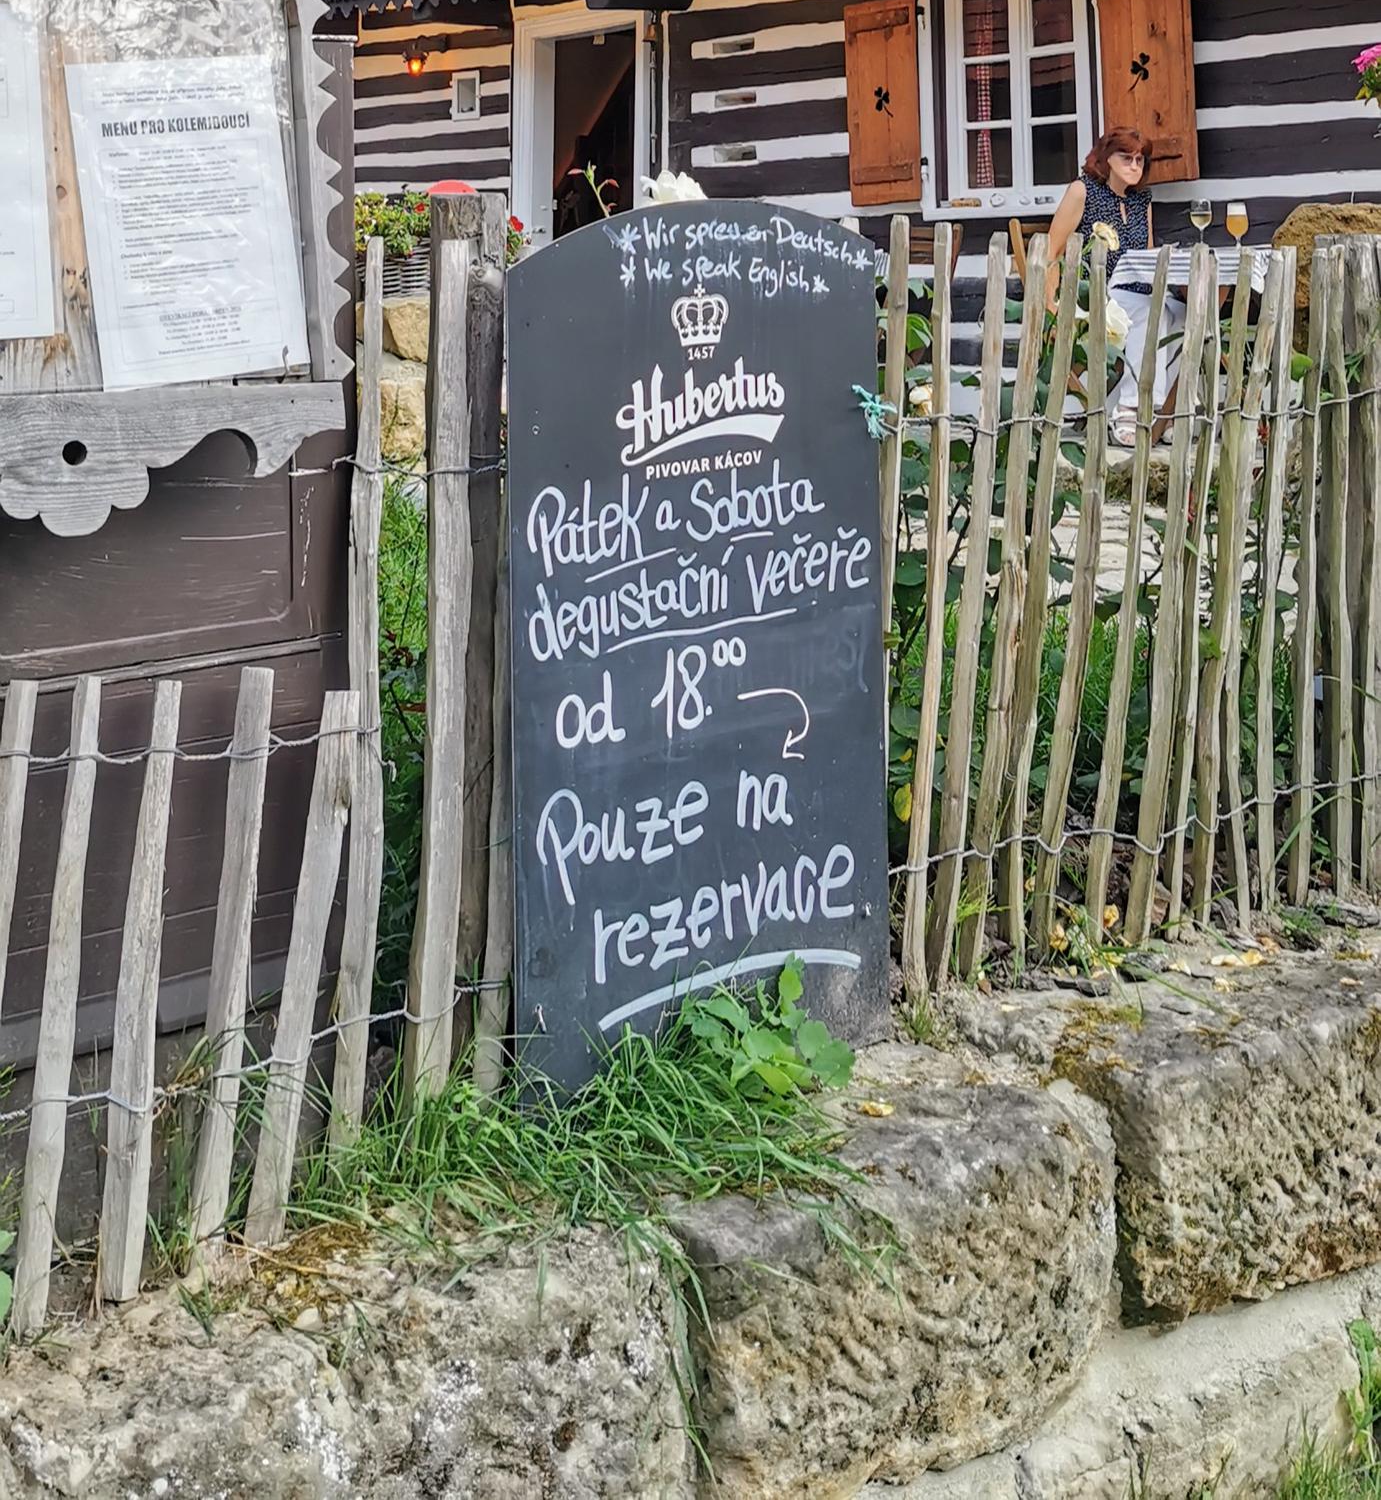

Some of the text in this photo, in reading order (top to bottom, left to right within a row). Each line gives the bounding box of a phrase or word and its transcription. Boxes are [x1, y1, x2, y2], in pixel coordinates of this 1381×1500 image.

[101, 121, 138, 138] MENU
[141, 118, 165, 135] PRO
[643, 216, 680, 246] Wir
[770, 215, 853, 267] Deutsch
[644, 251, 809, 298] We speak English
[687, 346, 715, 360] 1457
[615, 356, 785, 457] Hubertus
[646, 450, 762, 480] PIVOVAR KÁCOV
[527, 459, 825, 577] Pátek a Sobota
[528, 545, 734, 661] degustační
[536, 769, 793, 906] Pouze na
[593, 844, 855, 984] rezervace
